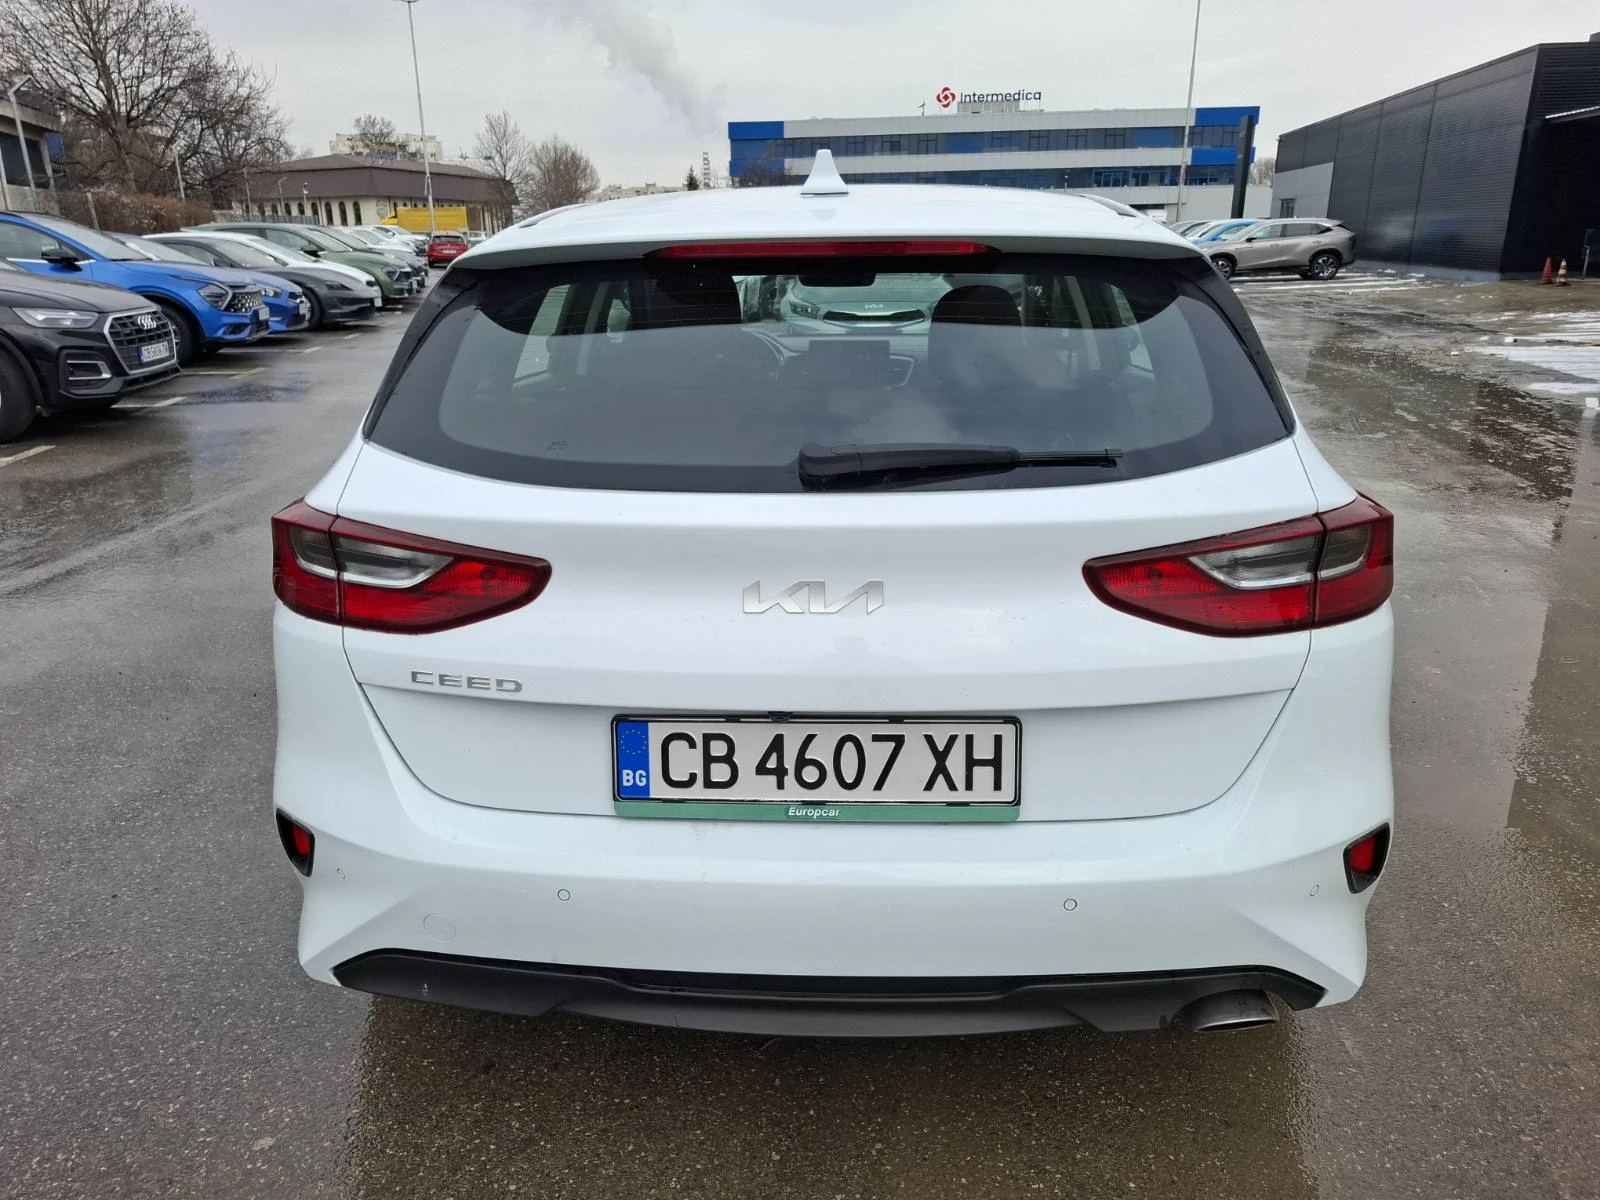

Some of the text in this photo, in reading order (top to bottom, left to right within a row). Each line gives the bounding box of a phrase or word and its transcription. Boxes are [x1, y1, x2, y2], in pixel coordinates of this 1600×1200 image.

[960, 89, 1042, 103] Intermedica
[411, 670, 523, 693] CEED
[660, 732, 1004, 792] CB 4607 XH
[622, 769, 647, 787] BG
[788, 806, 840, 819] Europcar
